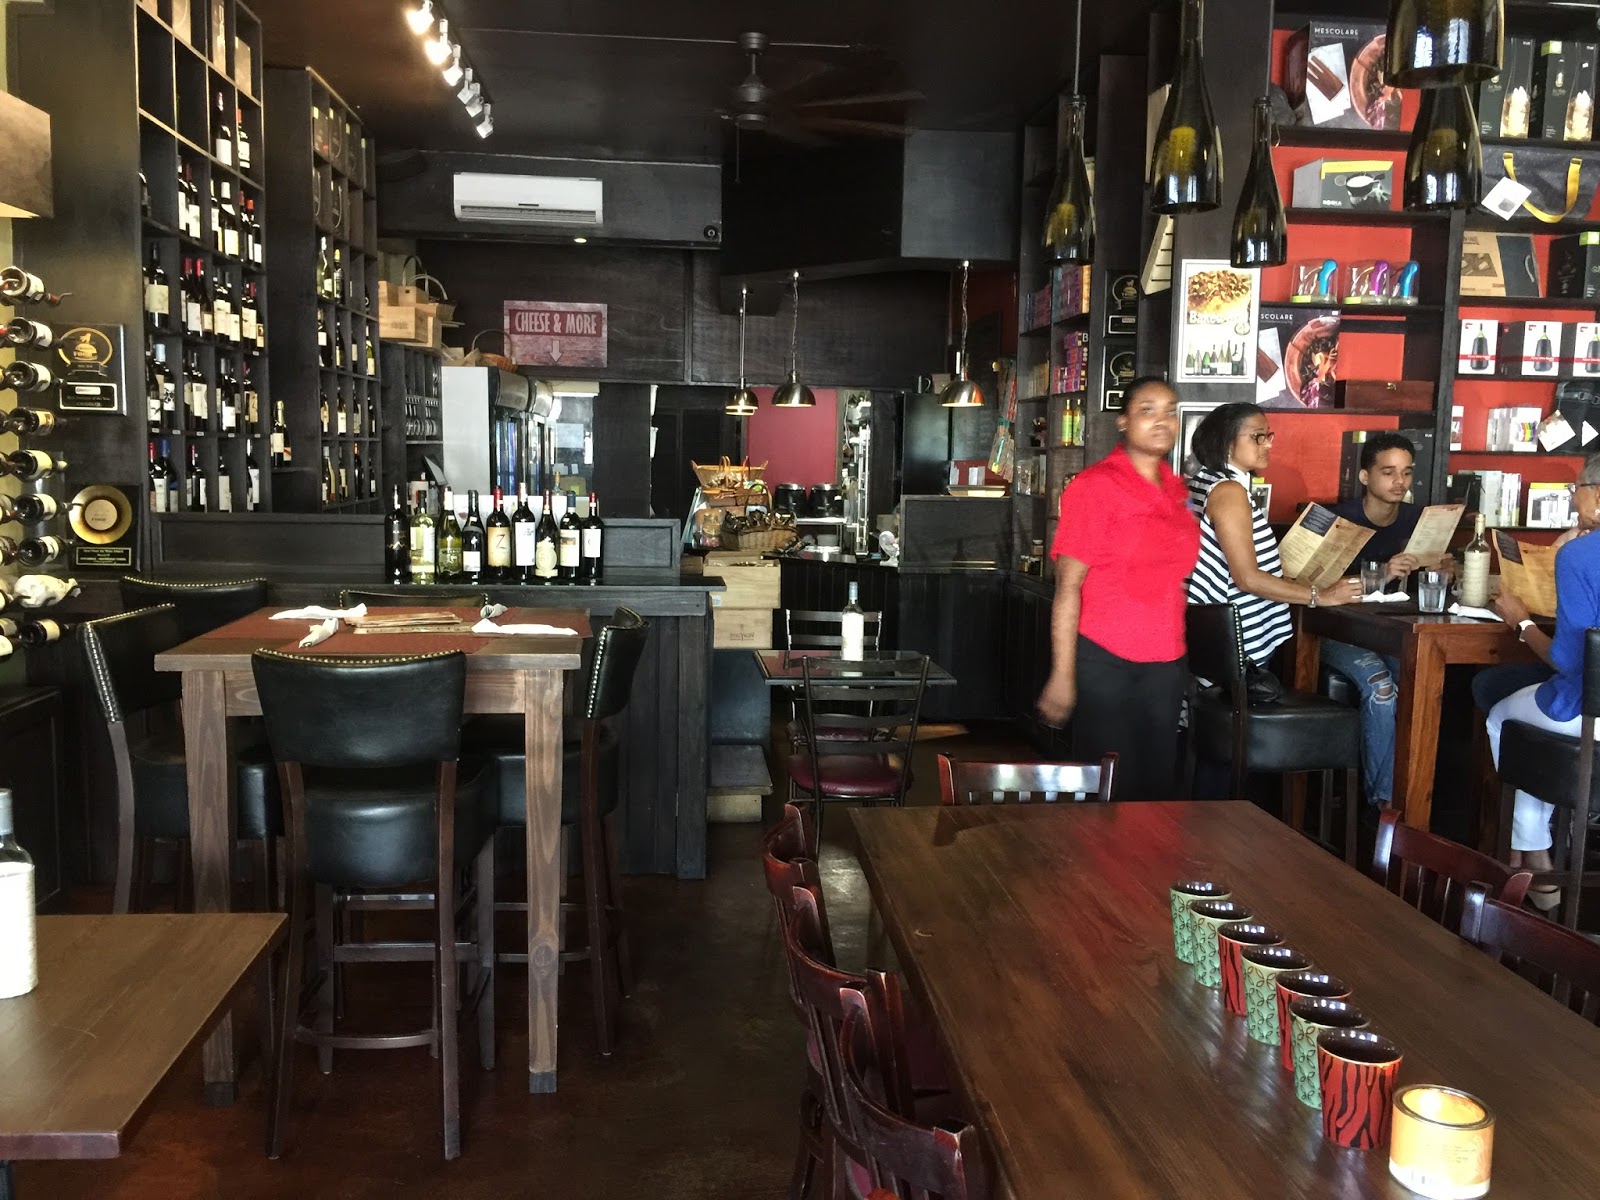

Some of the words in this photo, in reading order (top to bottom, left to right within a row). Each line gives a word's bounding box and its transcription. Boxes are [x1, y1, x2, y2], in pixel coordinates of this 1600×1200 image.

[1314, 27, 1359, 36] MESCOLARE
[514, 311, 550, 333] CHEESE
[553, 312, 562, 333] &
[565, 313, 597, 334] MORE
